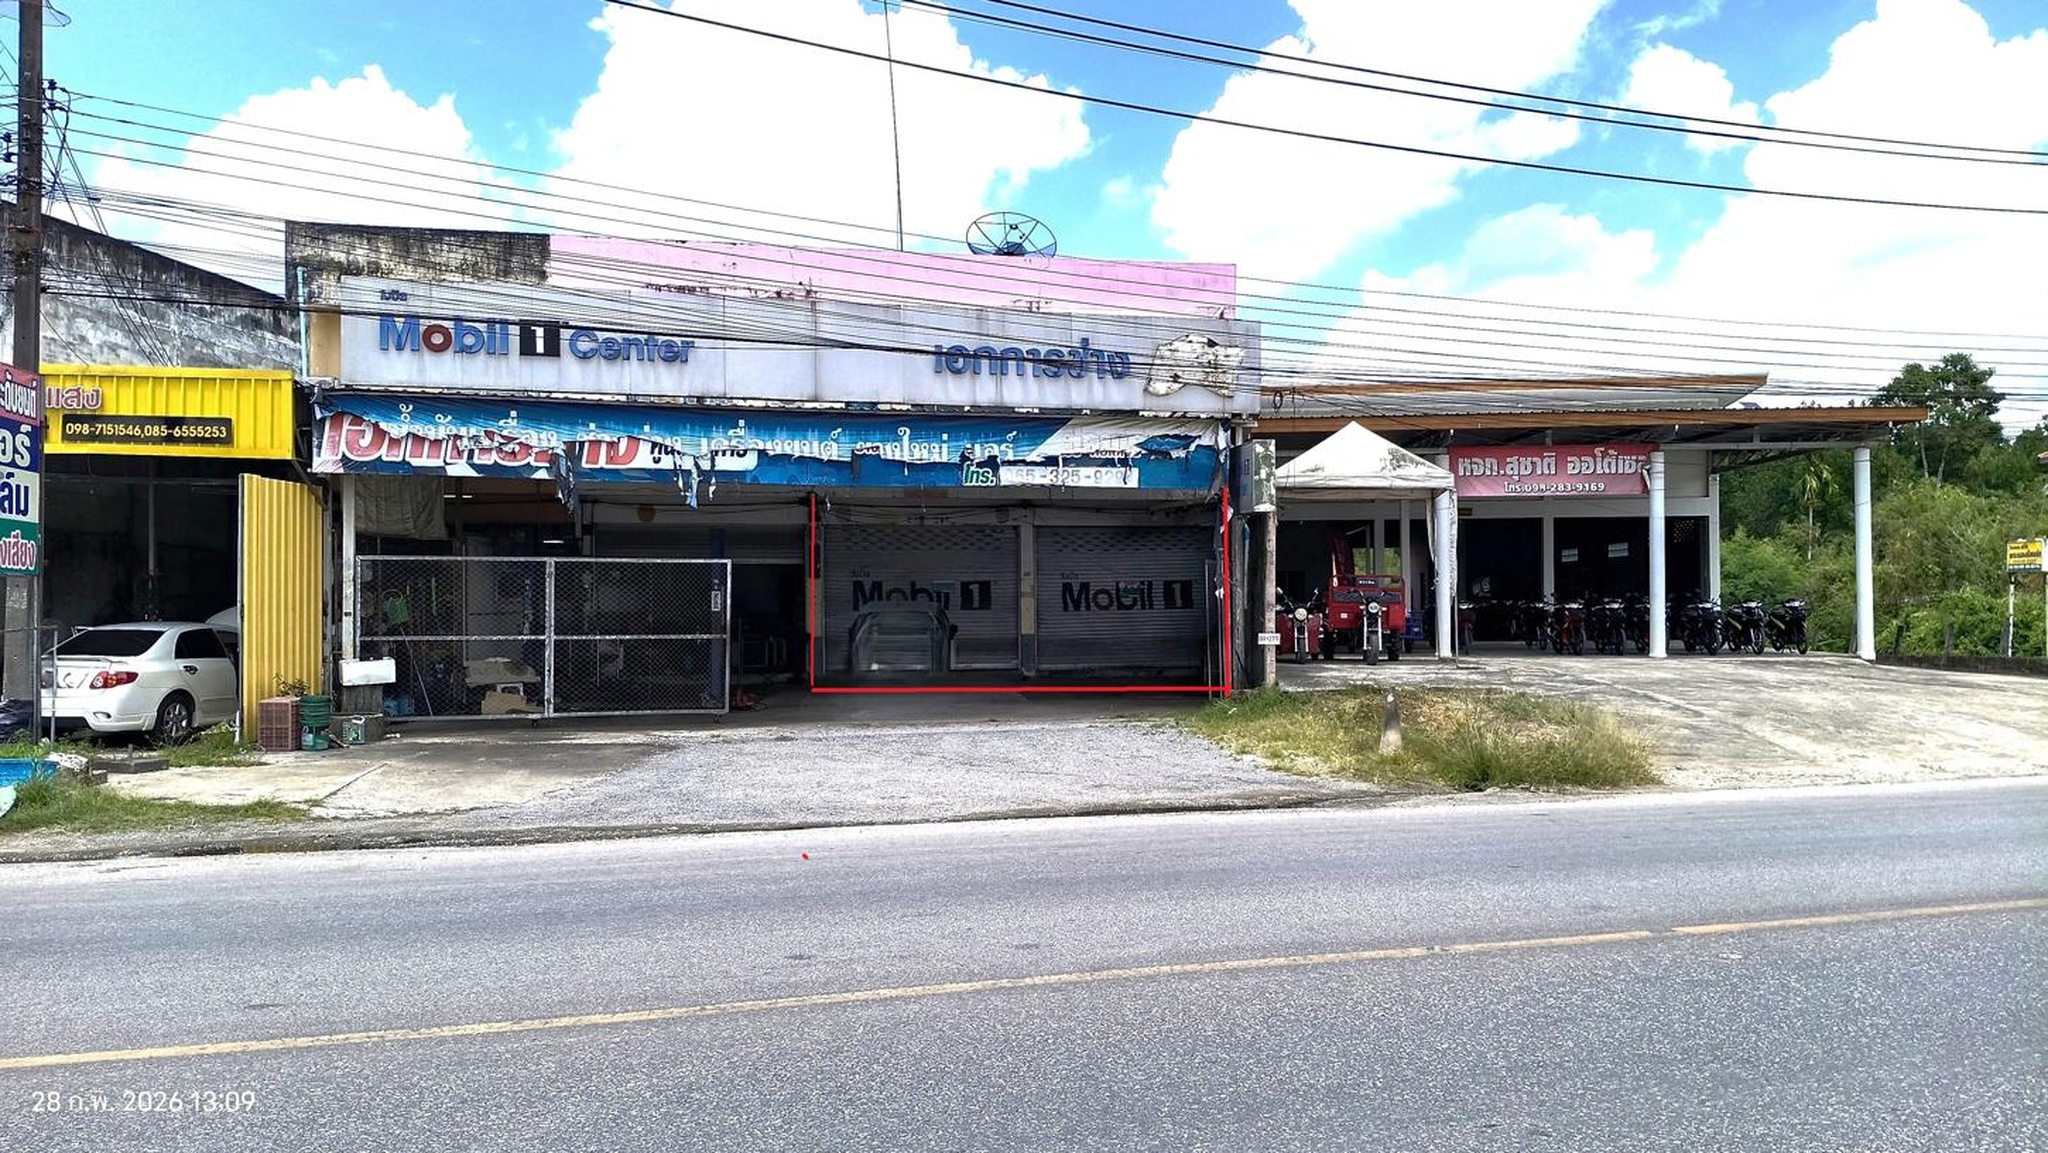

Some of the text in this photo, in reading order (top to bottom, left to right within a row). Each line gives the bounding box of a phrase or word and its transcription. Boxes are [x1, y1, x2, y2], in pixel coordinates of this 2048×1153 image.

[379, 315, 509, 354] Mobil
[569, 329, 694, 363] Center
[933, 337, 1131, 380] เอกการช่าง
[65, 422, 228, 439] 098-7151546,085-6555253
